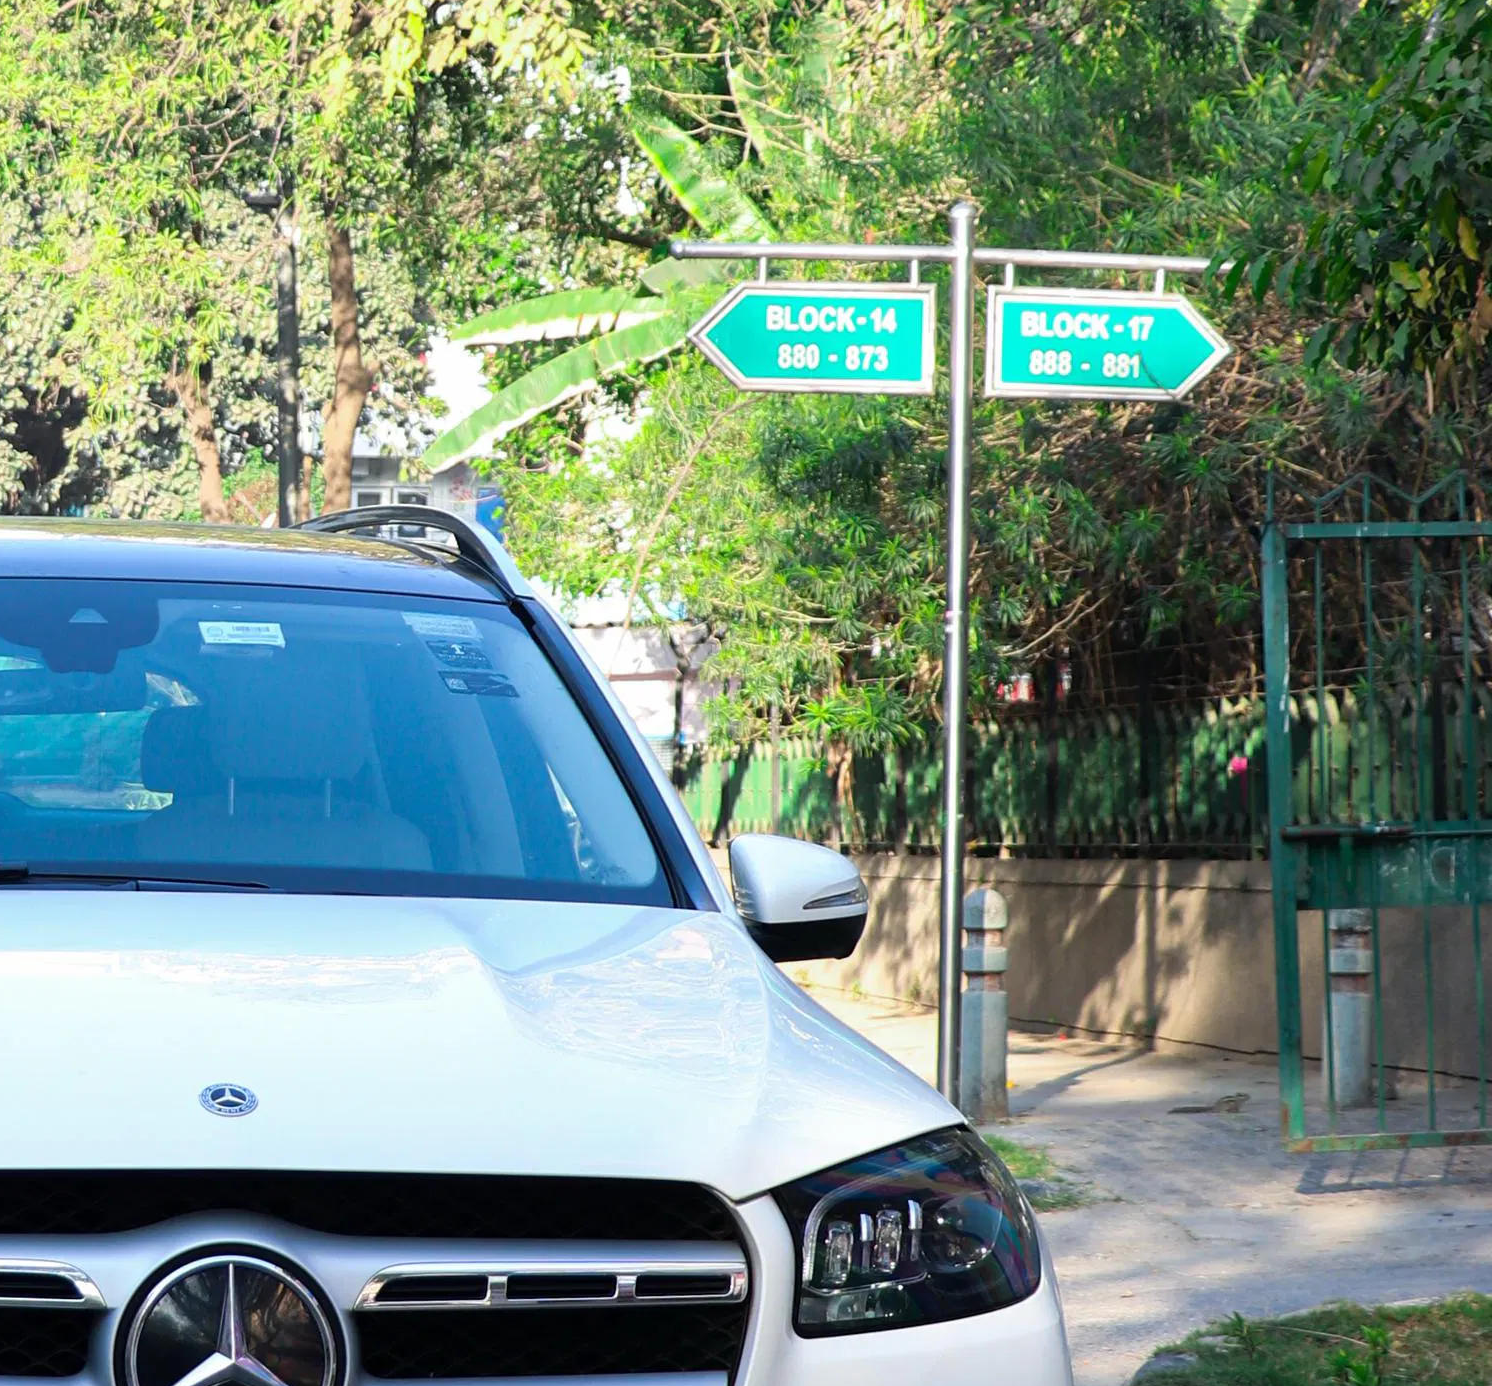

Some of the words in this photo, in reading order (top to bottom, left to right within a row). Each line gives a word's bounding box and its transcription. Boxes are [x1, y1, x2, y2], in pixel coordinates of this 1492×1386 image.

[777, 343, 819, 370] 880
[845, 344, 889, 372] 873
[1029, 349, 1072, 377] 888
[1102, 353, 1140, 379] 881
